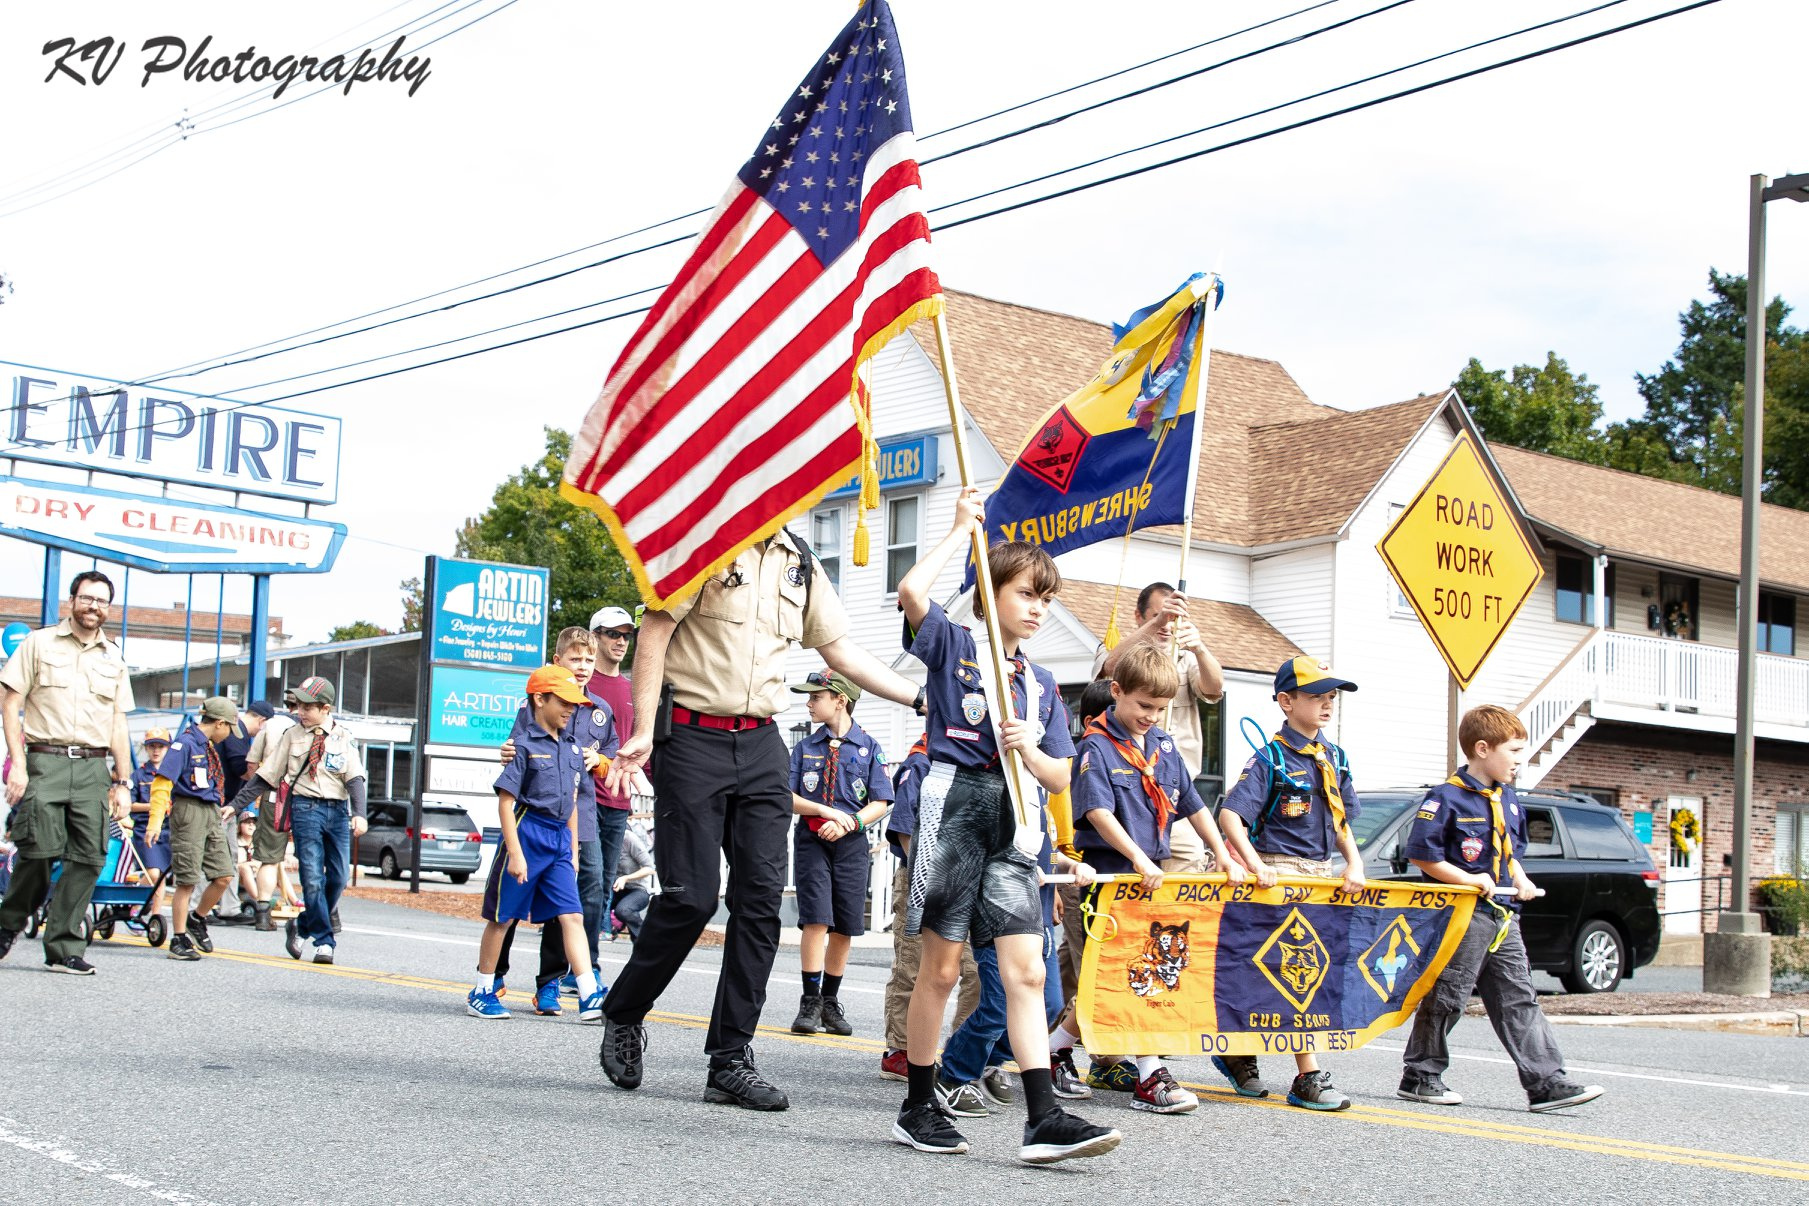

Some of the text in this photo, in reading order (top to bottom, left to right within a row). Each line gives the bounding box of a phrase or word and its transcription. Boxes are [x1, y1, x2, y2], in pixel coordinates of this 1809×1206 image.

[10, 375, 325, 489] EMPIRE
[16, 494, 311, 550] DRY CLEANING
[1436, 495, 1494, 531] ROAD
[1436, 541, 1494, 577] WORK
[478, 568, 542, 605] ARTIN
[475, 598, 542, 626] JEWLERS
[1434, 587, 1503, 624] 500 FT
[450, 618, 486, 638] Designs
[441, 713, 468, 728] HAIR
[1114, 882, 1152, 901] BSA
[1175, 884, 1225, 902] PACK
[1232, 884, 1254, 901] 62
[1329, 888, 1390, 906] STONE
[1408, 890, 1462, 908] POST
[1146, 999, 1162, 1009] Tiger
[1249, 1012, 1281, 1028] CUB
[1201, 1031, 1357, 1053] DO YOUR BEST
